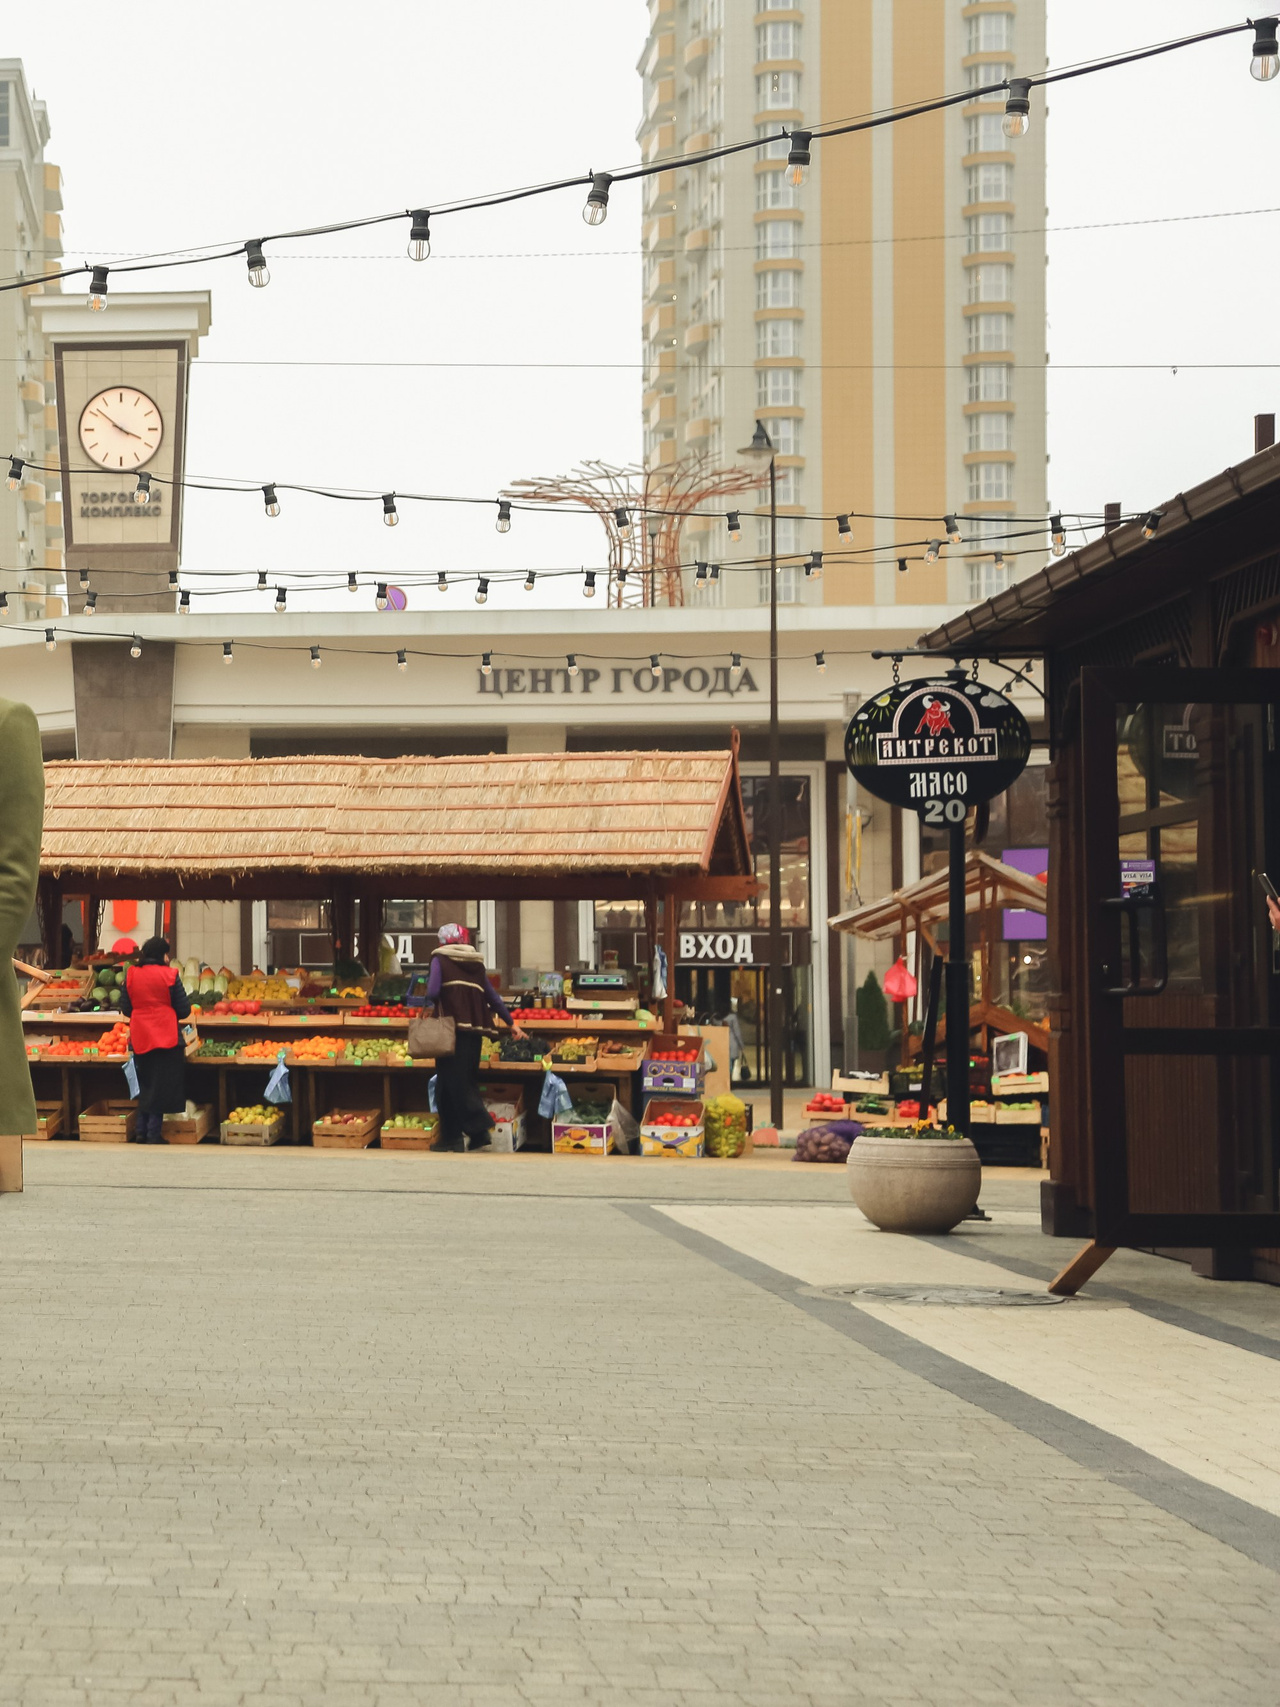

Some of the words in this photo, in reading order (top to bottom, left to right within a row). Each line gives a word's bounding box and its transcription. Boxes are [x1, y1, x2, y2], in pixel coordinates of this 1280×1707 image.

[80, 488, 162, 504] ТОРГОВЙ
[80, 505, 162, 518] КОМПЛЕКС
[477, 667, 601, 699] ЦЕНТР
[611, 667, 759, 698] ГОРОДА
[882, 736, 992, 758] АНТРЕКОТ
[909, 771, 968, 798] МЯСО
[924, 799, 966, 823] 20
[680, 934, 754, 963] ВХОД
